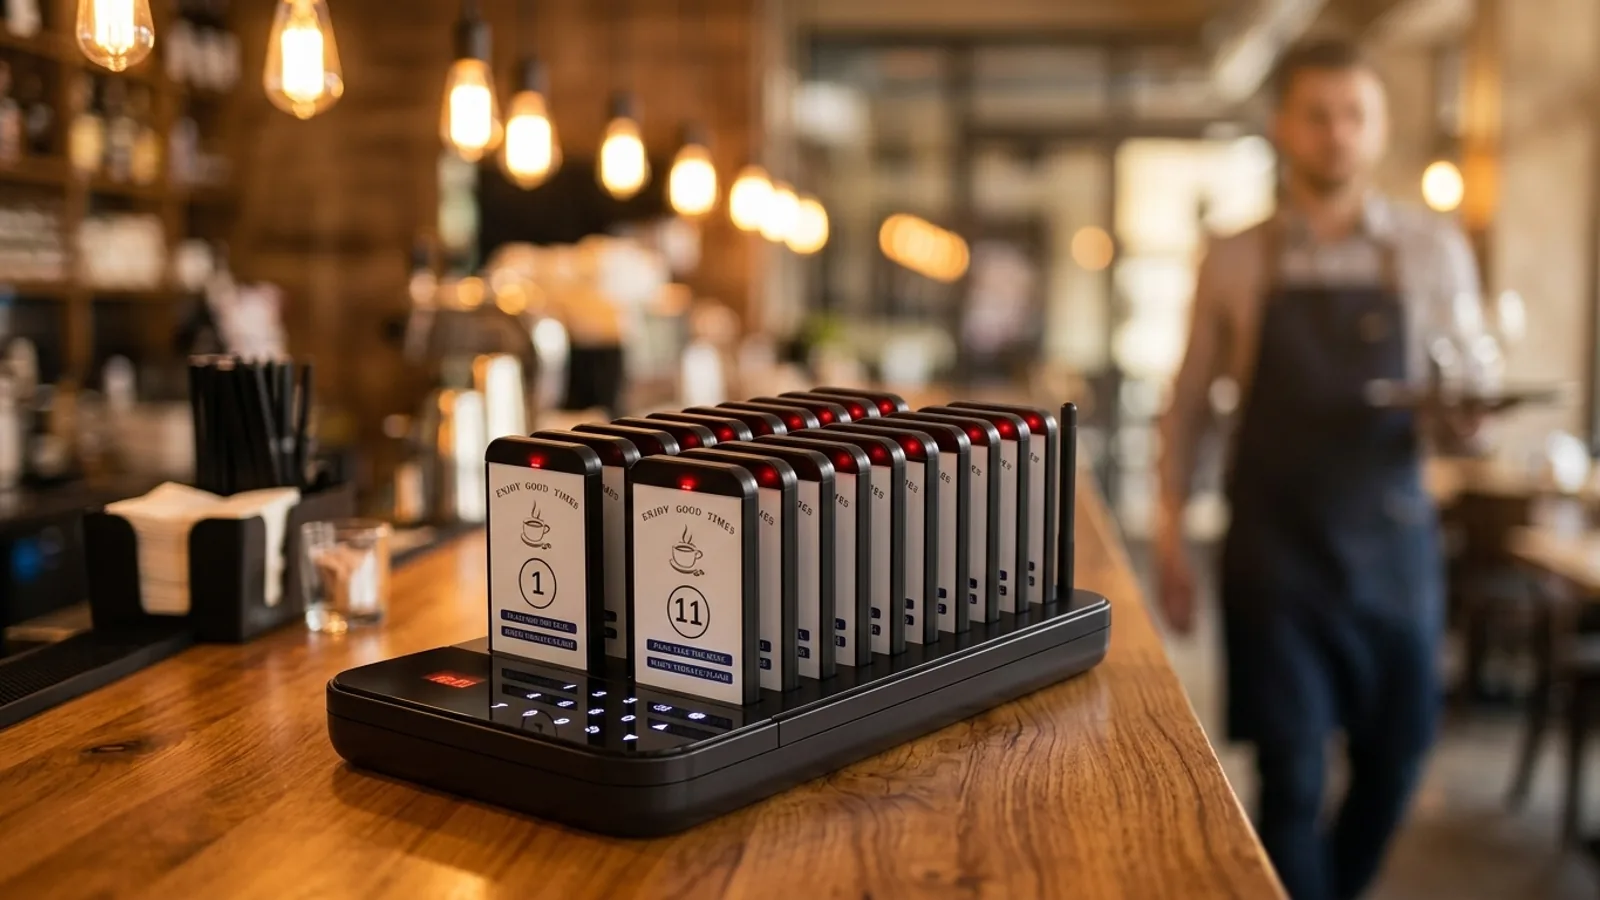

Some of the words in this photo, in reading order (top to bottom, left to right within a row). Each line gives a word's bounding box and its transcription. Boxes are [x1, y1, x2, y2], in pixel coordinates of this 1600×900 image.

[496, 482, 521, 498] ENJOY
[525, 482, 549, 493] GOOD
[676, 504, 702, 516] GOOD
[707, 512, 735, 535] TIMES
[532, 571, 544, 596] 1
[675, 598, 702, 626] 11
